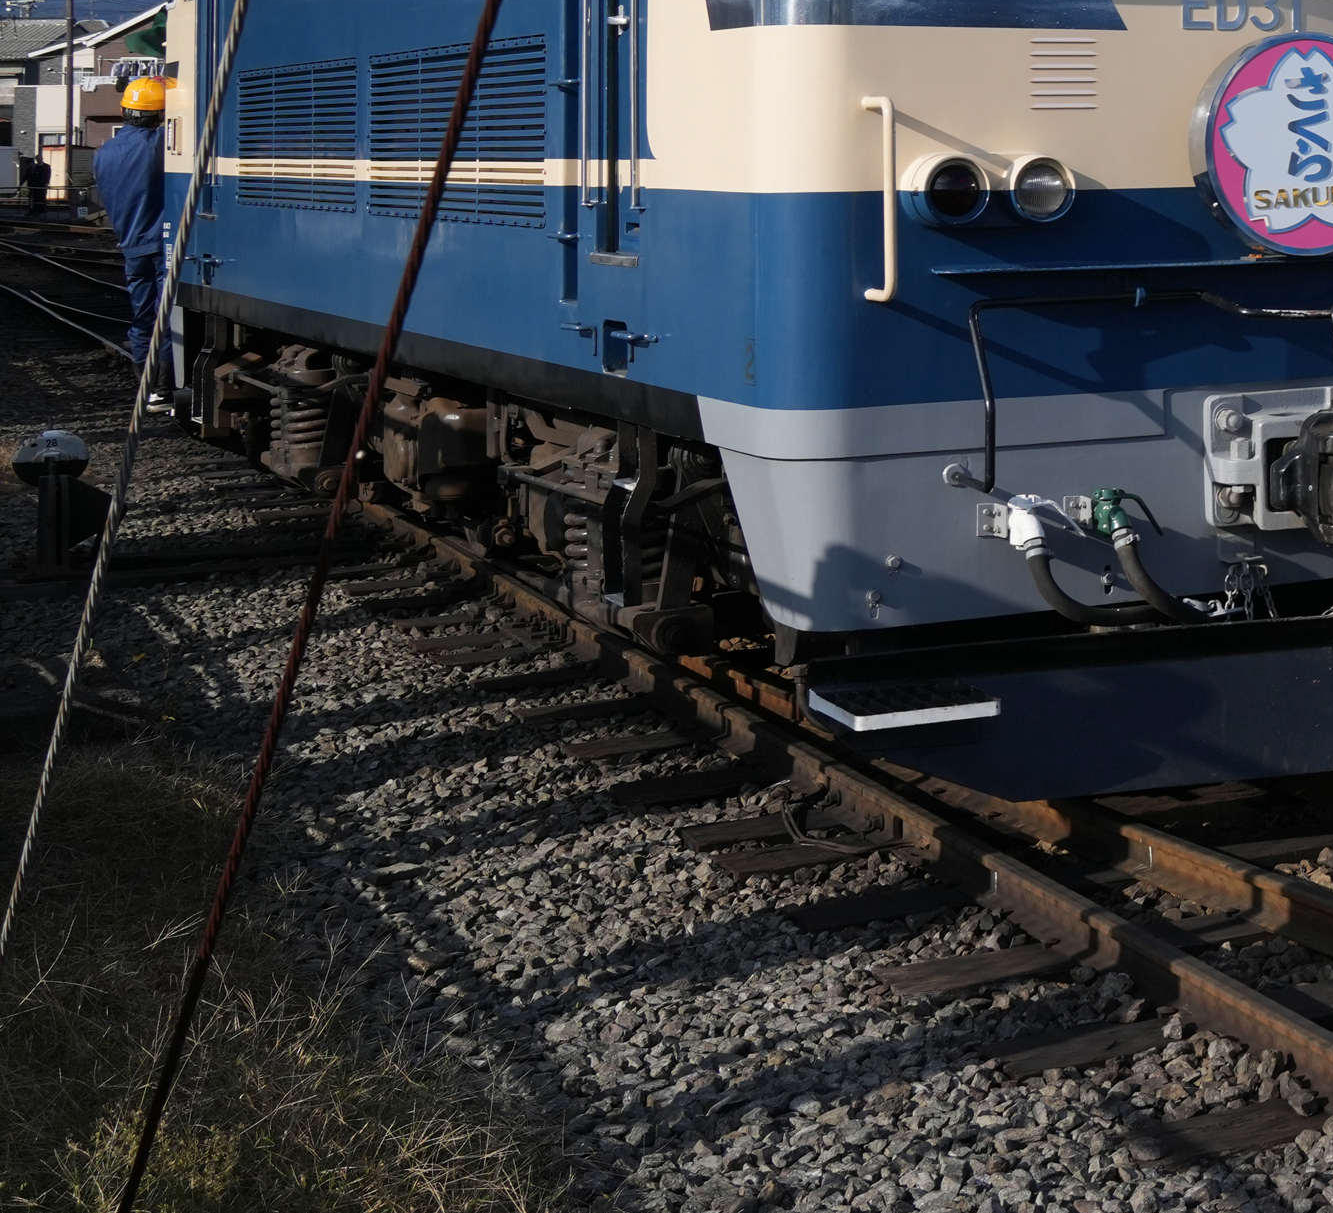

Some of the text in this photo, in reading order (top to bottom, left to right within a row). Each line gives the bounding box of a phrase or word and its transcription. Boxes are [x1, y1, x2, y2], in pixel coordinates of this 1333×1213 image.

[1285, 66, 1332, 182] さくら
[45, 438, 58, 448] 28
